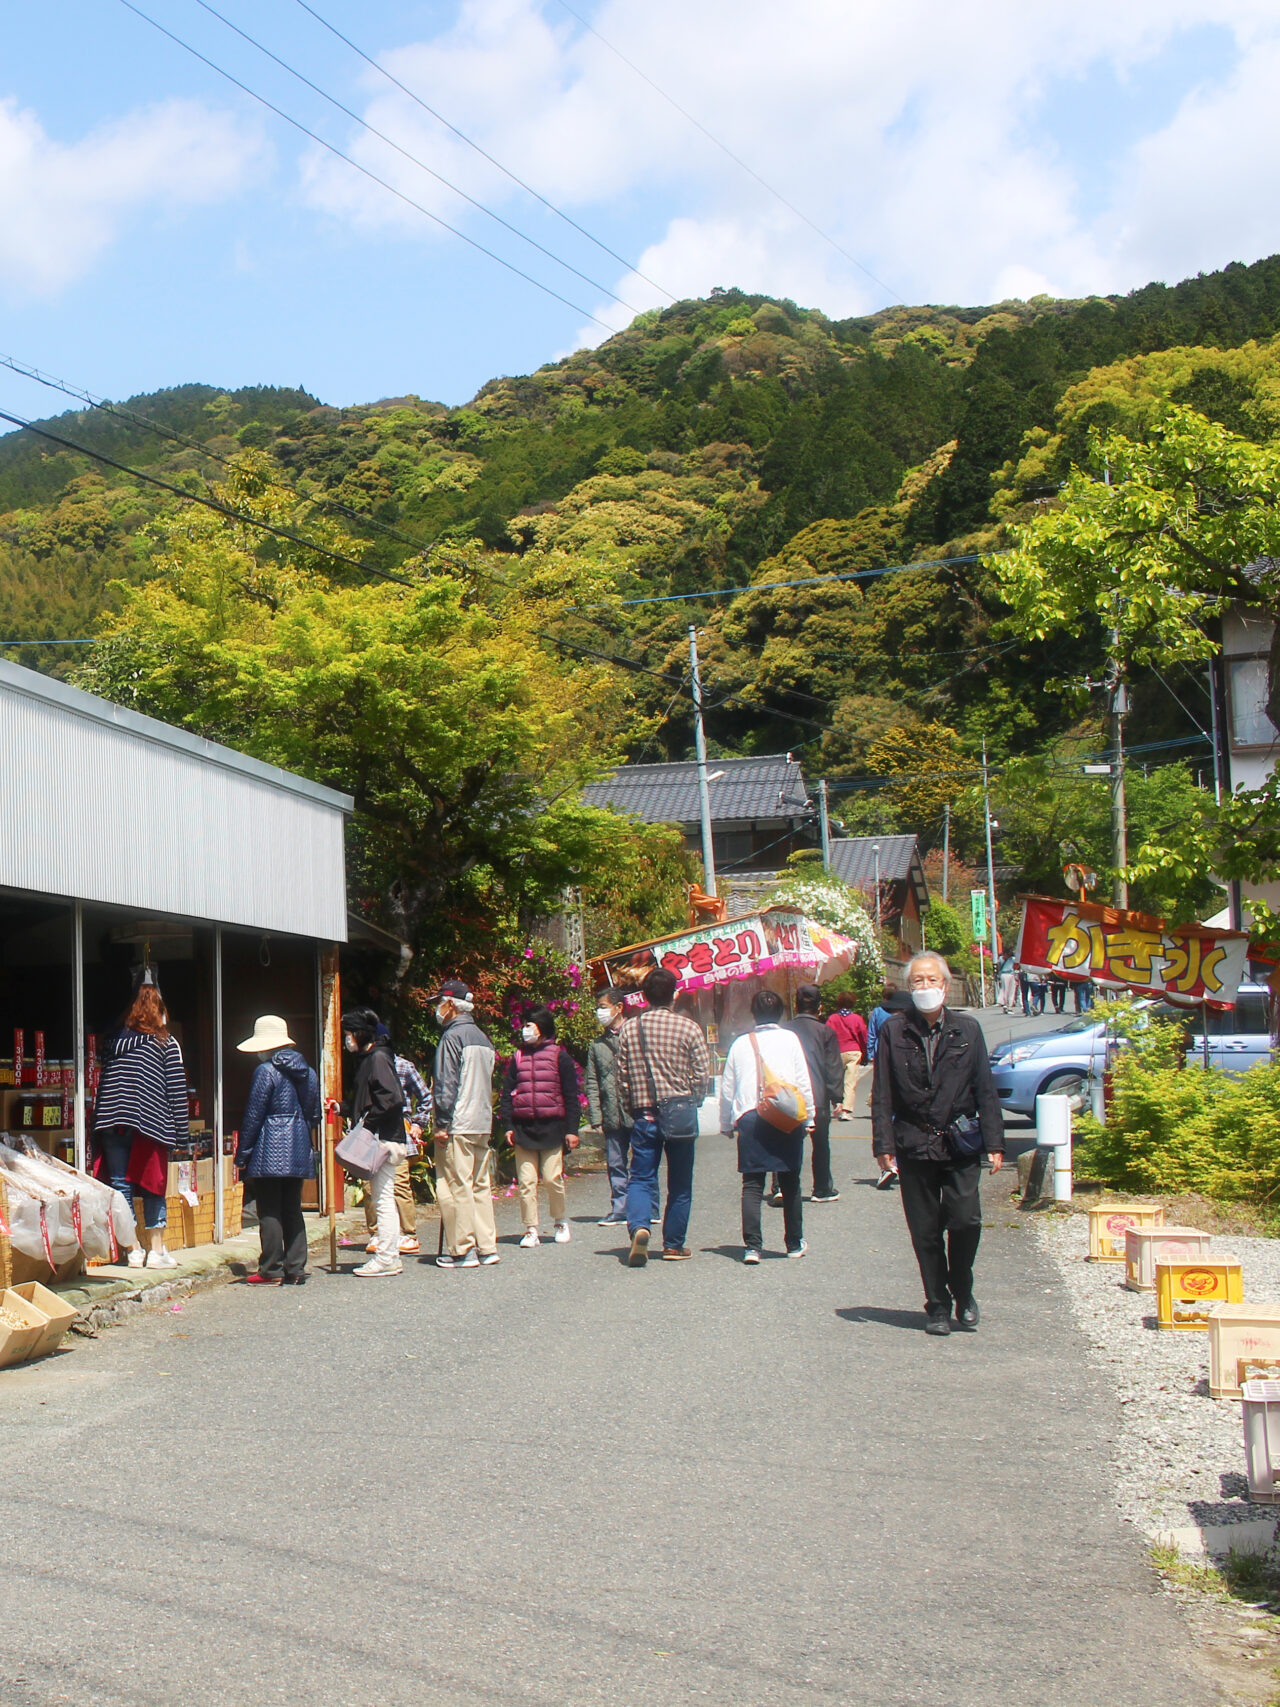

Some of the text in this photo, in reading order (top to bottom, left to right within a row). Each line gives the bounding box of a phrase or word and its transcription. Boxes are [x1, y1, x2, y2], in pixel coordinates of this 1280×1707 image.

[660, 929, 761, 980] やきとり
[1045, 912, 1227, 993] かき氷
